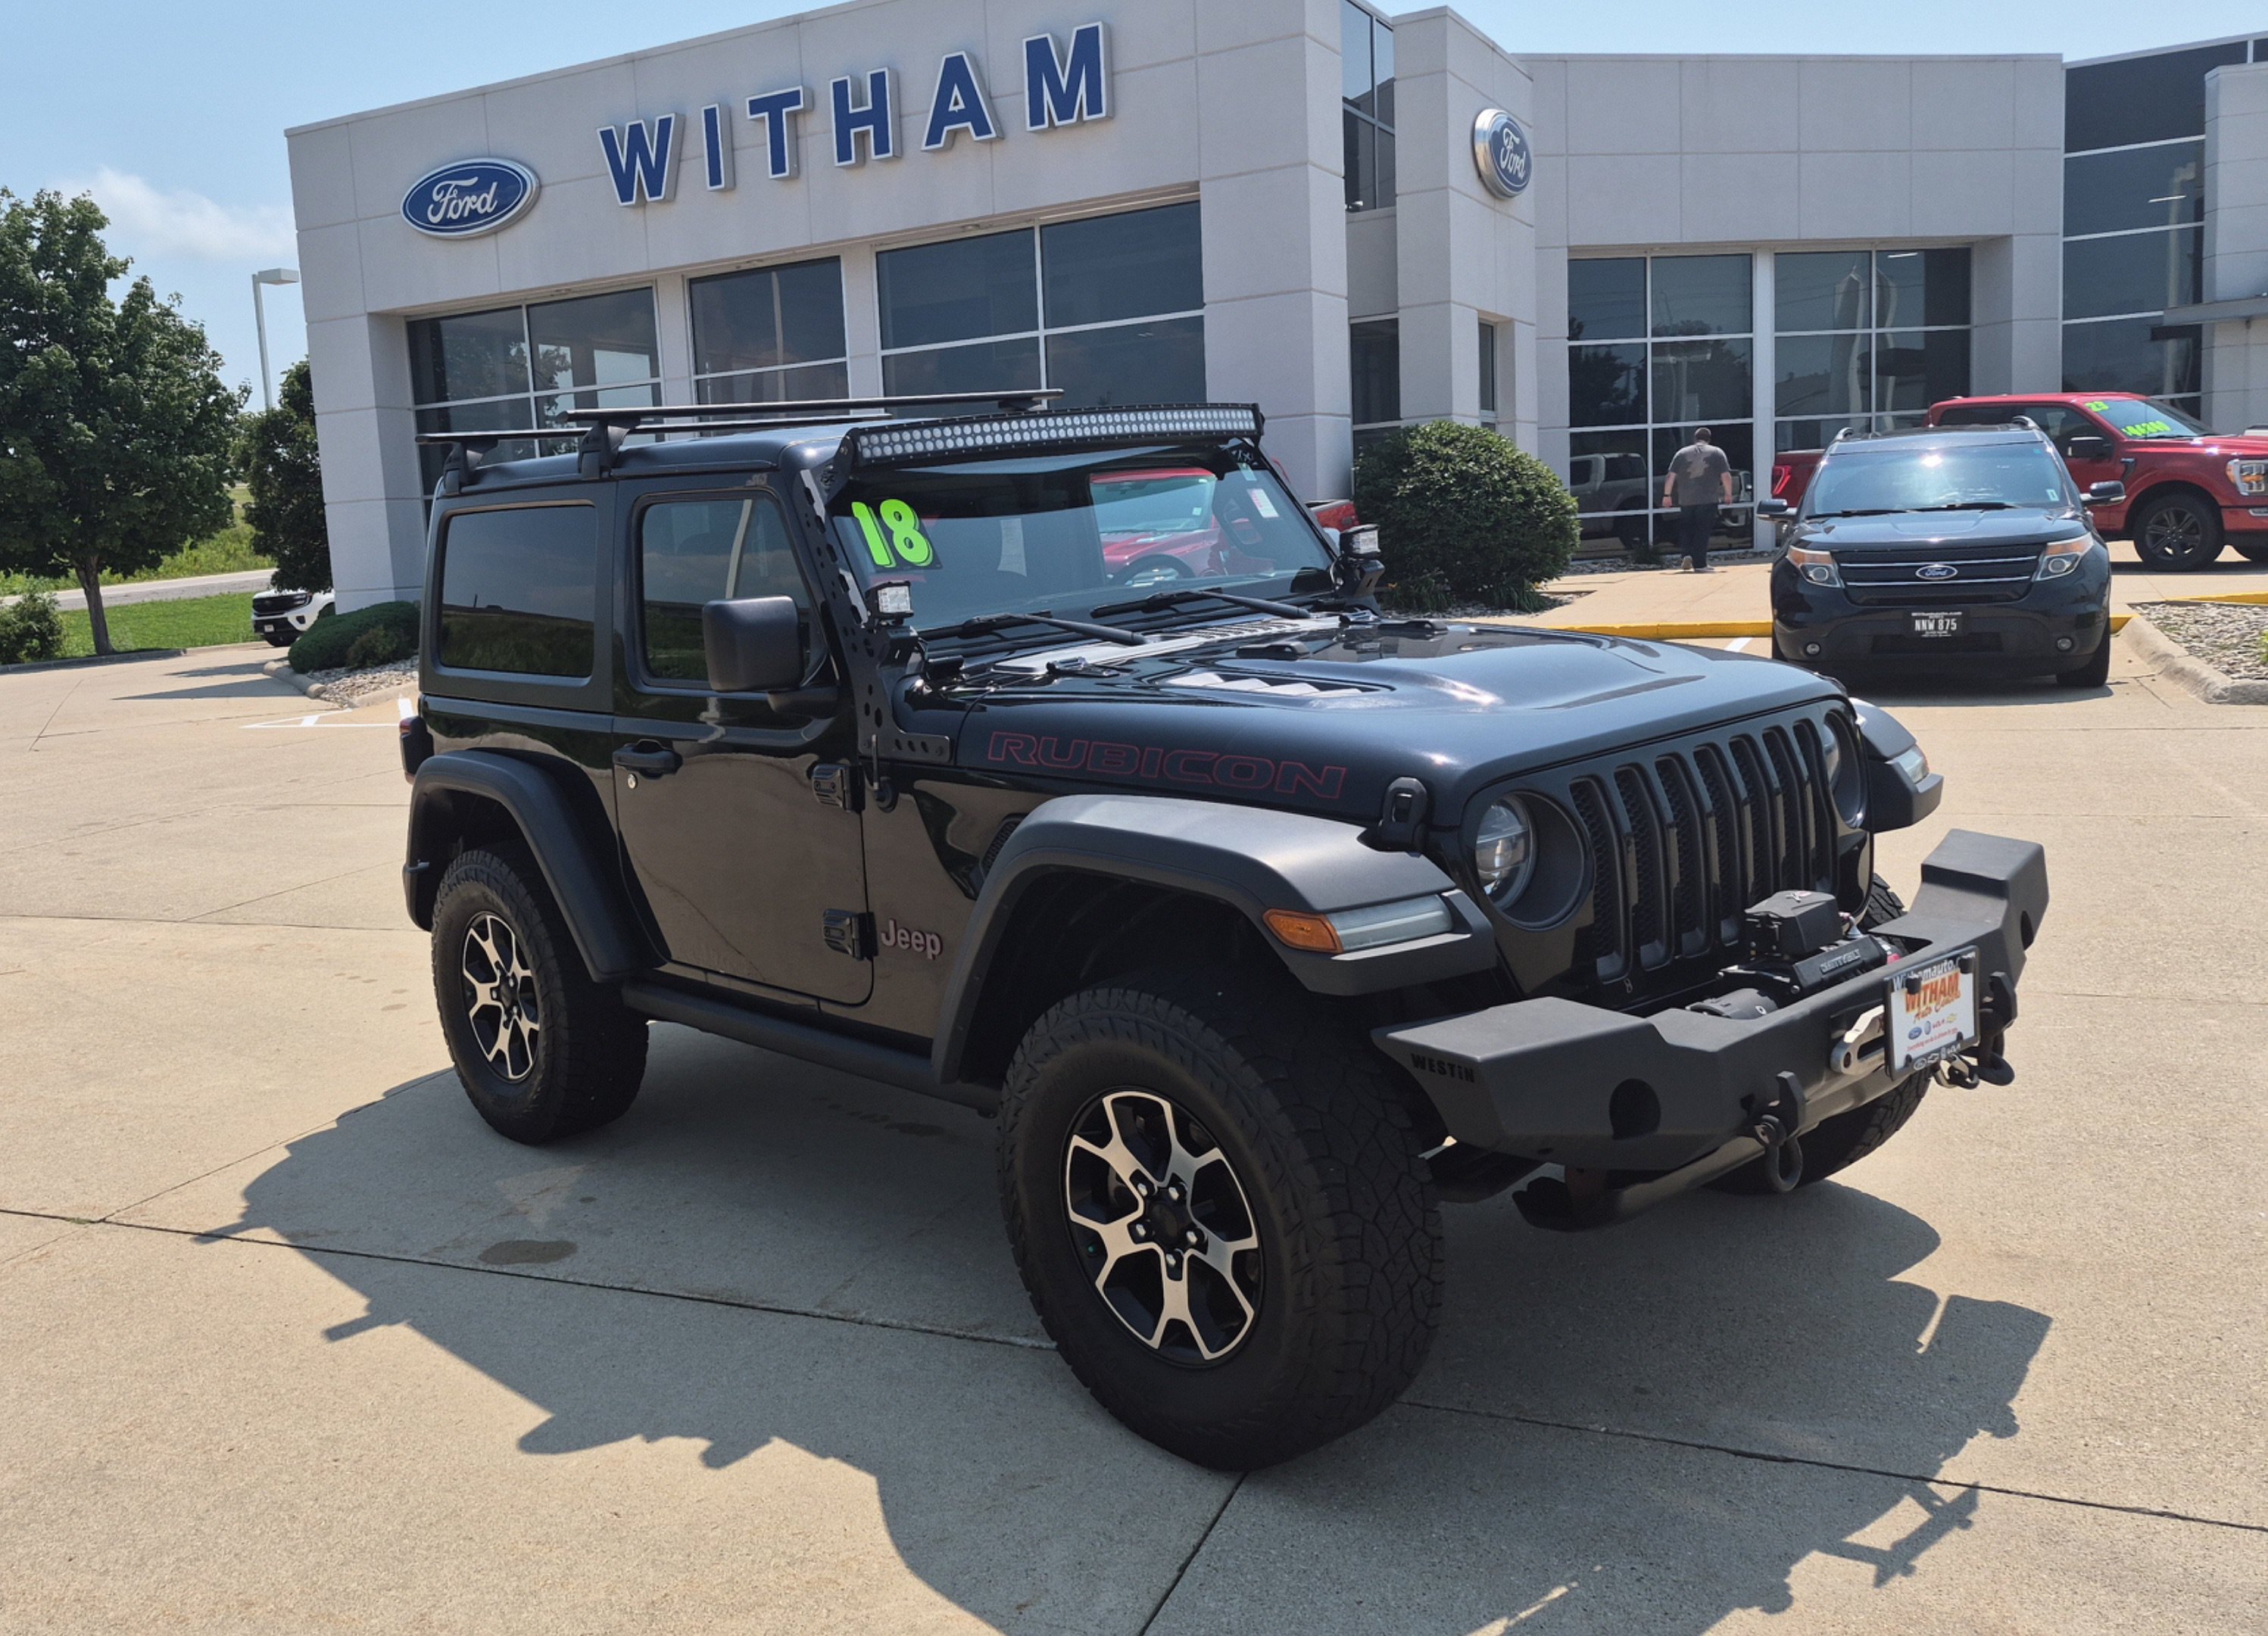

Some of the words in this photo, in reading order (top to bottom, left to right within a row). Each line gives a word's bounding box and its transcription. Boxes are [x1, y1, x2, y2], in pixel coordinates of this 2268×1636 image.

[597, 20, 1110, 207] WITHAM
[1500, 127, 1526, 179] Ford
[427, 176, 498, 223] Ford
[851, 499, 933, 568] 18
[1914, 619, 1936, 631] NNW
[1938, 619, 1958, 631] 875
[987, 731, 1346, 799] RUBICON
[881, 918, 943, 960] Jeep
[1905, 971, 1961, 1013] WITHAM
